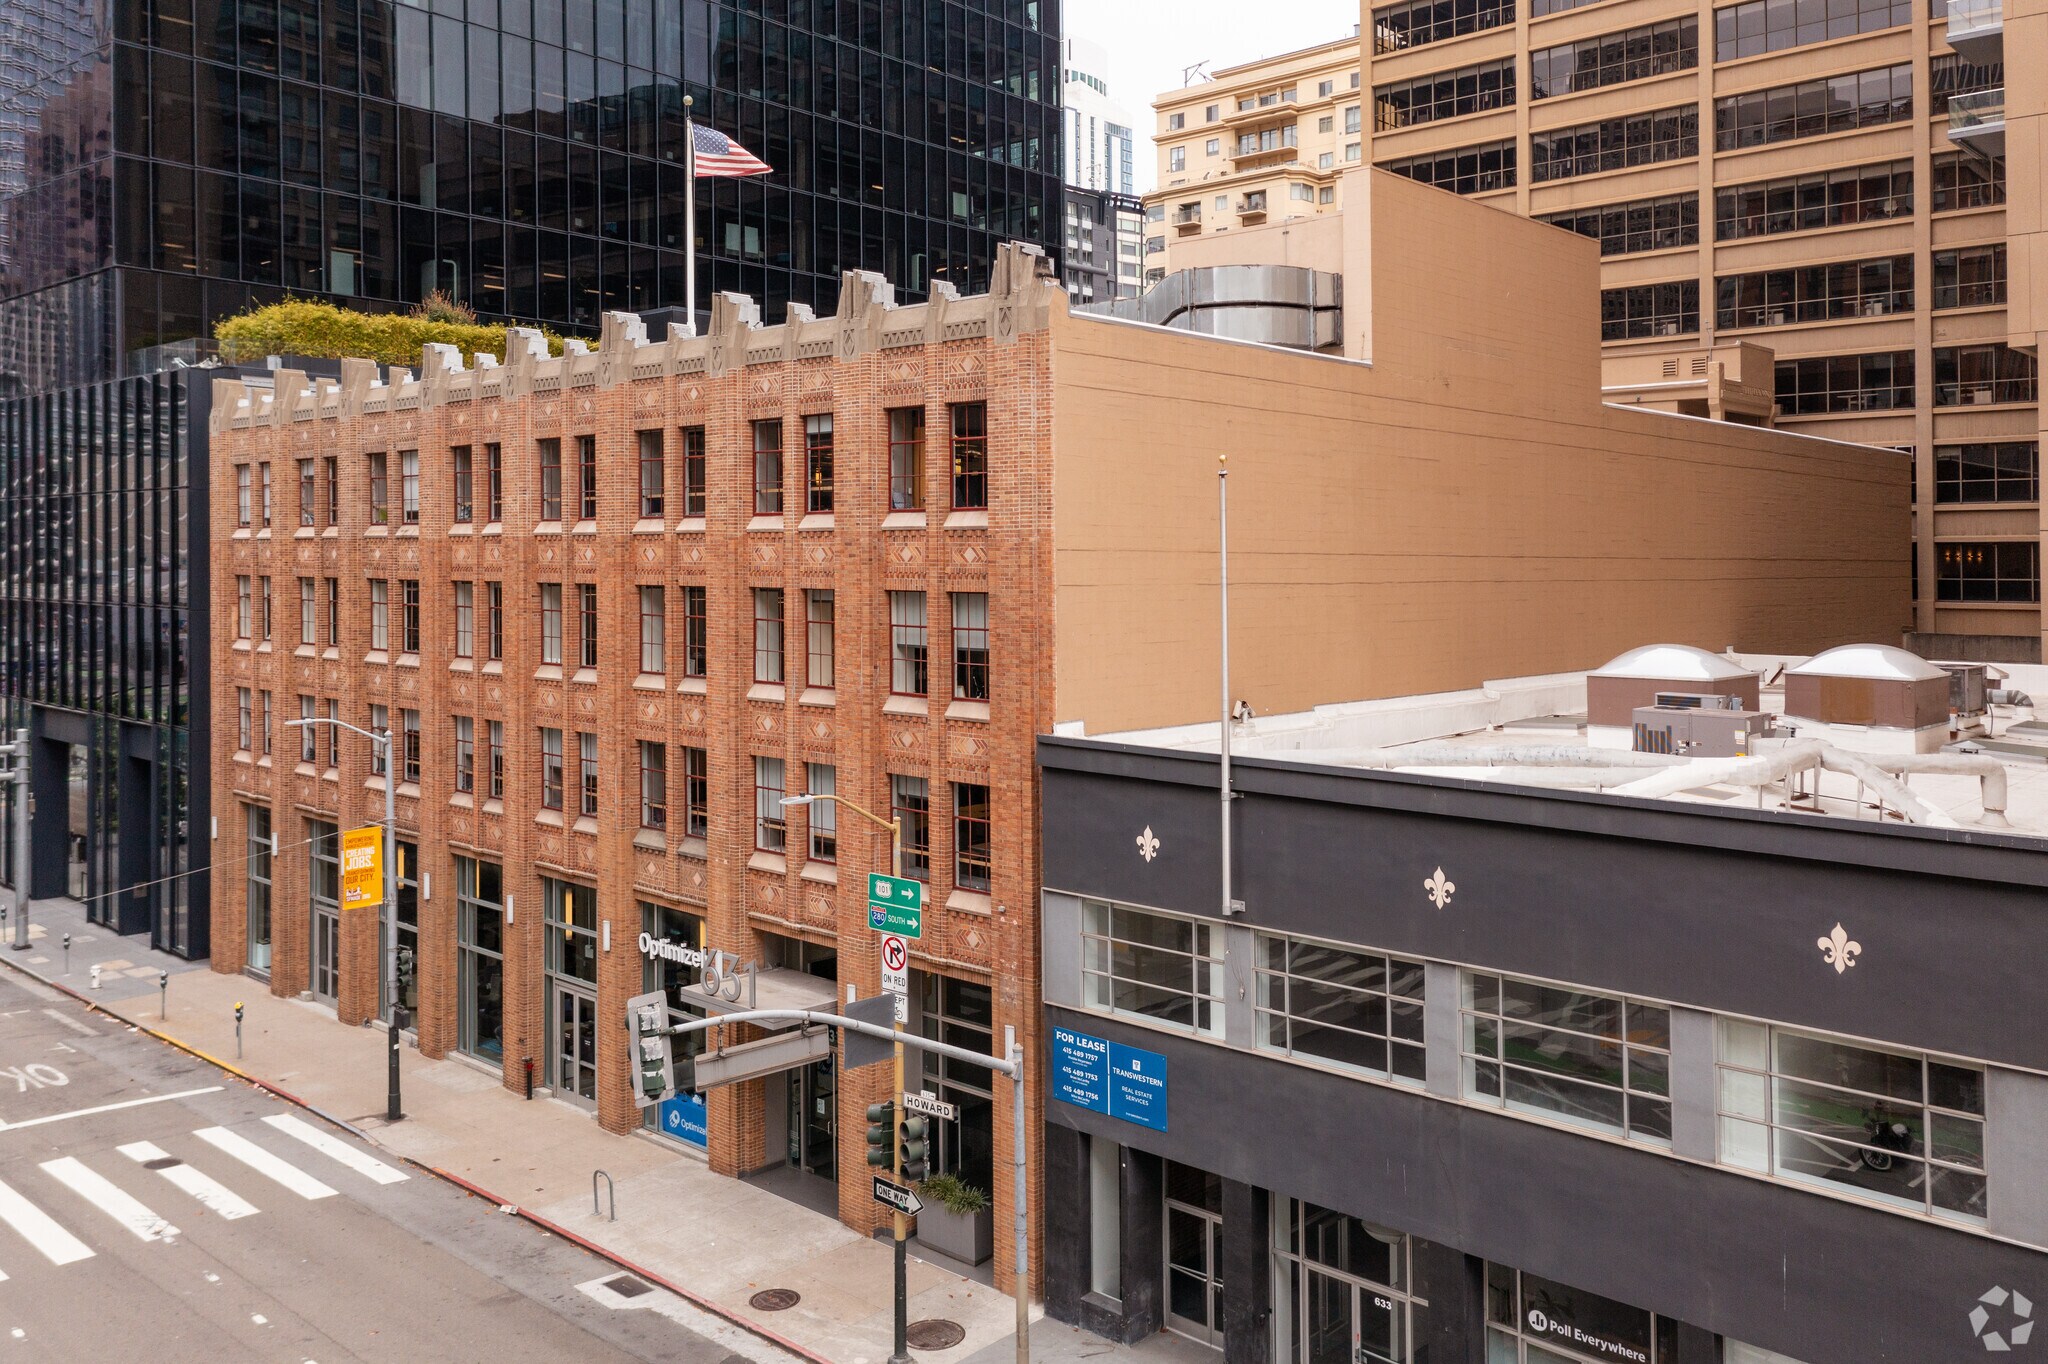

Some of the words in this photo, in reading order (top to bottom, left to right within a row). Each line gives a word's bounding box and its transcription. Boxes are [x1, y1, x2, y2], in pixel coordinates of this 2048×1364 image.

[346, 846, 375, 858] CREATING
[346, 855, 374, 870] JOBS.
[346, 876, 358, 884] OUR
[879, 885, 889, 893] 101
[873, 911, 885, 921] 280
[887, 914, 906, 925] SOUTH
[639, 931, 708, 968] Optimizel
[701, 949, 757, 1010] 631
[883, 973, 892, 983] ON
[894, 976, 906, 987] RED
[1056, 1031, 1074, 1044] FOR
[1076, 1037, 1106, 1053] LEASE
[1085, 1053, 1099, 1061] 1757
[1062, 1066, 1071, 1074] 415
[1113, 1067, 1162, 1087] TRANSWESTERN
[1122, 1086, 1134, 1094] REAL
[1135, 1090, 1153, 1100] ESTATE
[906, 1097, 950, 1116] HOWARD
[1125, 1095, 1149, 1106] SERVICES
[878, 1186, 891, 1198] ONE
[893, 1193, 908, 1206] WAY
[1374, 1297, 1392, 1310] 633
[1550, 1319, 1571, 1338] Poll
[1574, 1328, 1646, 1363] Everywhere
